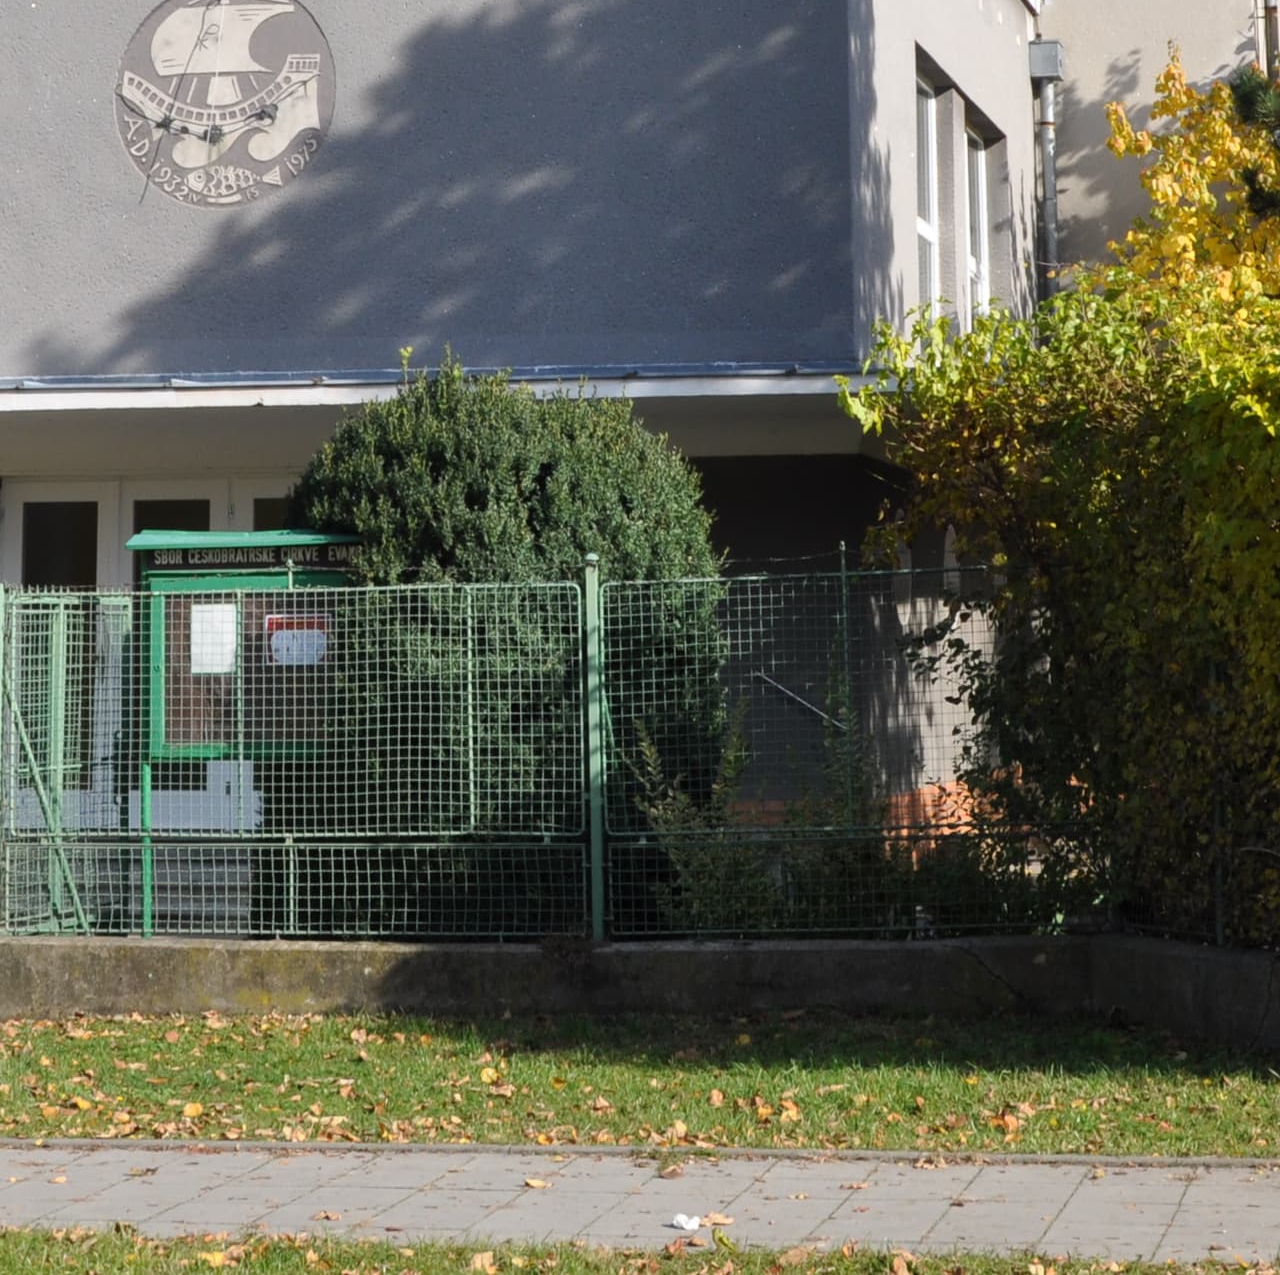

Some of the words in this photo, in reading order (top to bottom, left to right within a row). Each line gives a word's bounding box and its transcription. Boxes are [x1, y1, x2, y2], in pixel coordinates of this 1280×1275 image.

[123, 115, 150, 163] A.D.
[147, 158, 190, 202] 1932
[283, 134, 318, 176] 1975
[153, 549, 184, 565] SBOR
